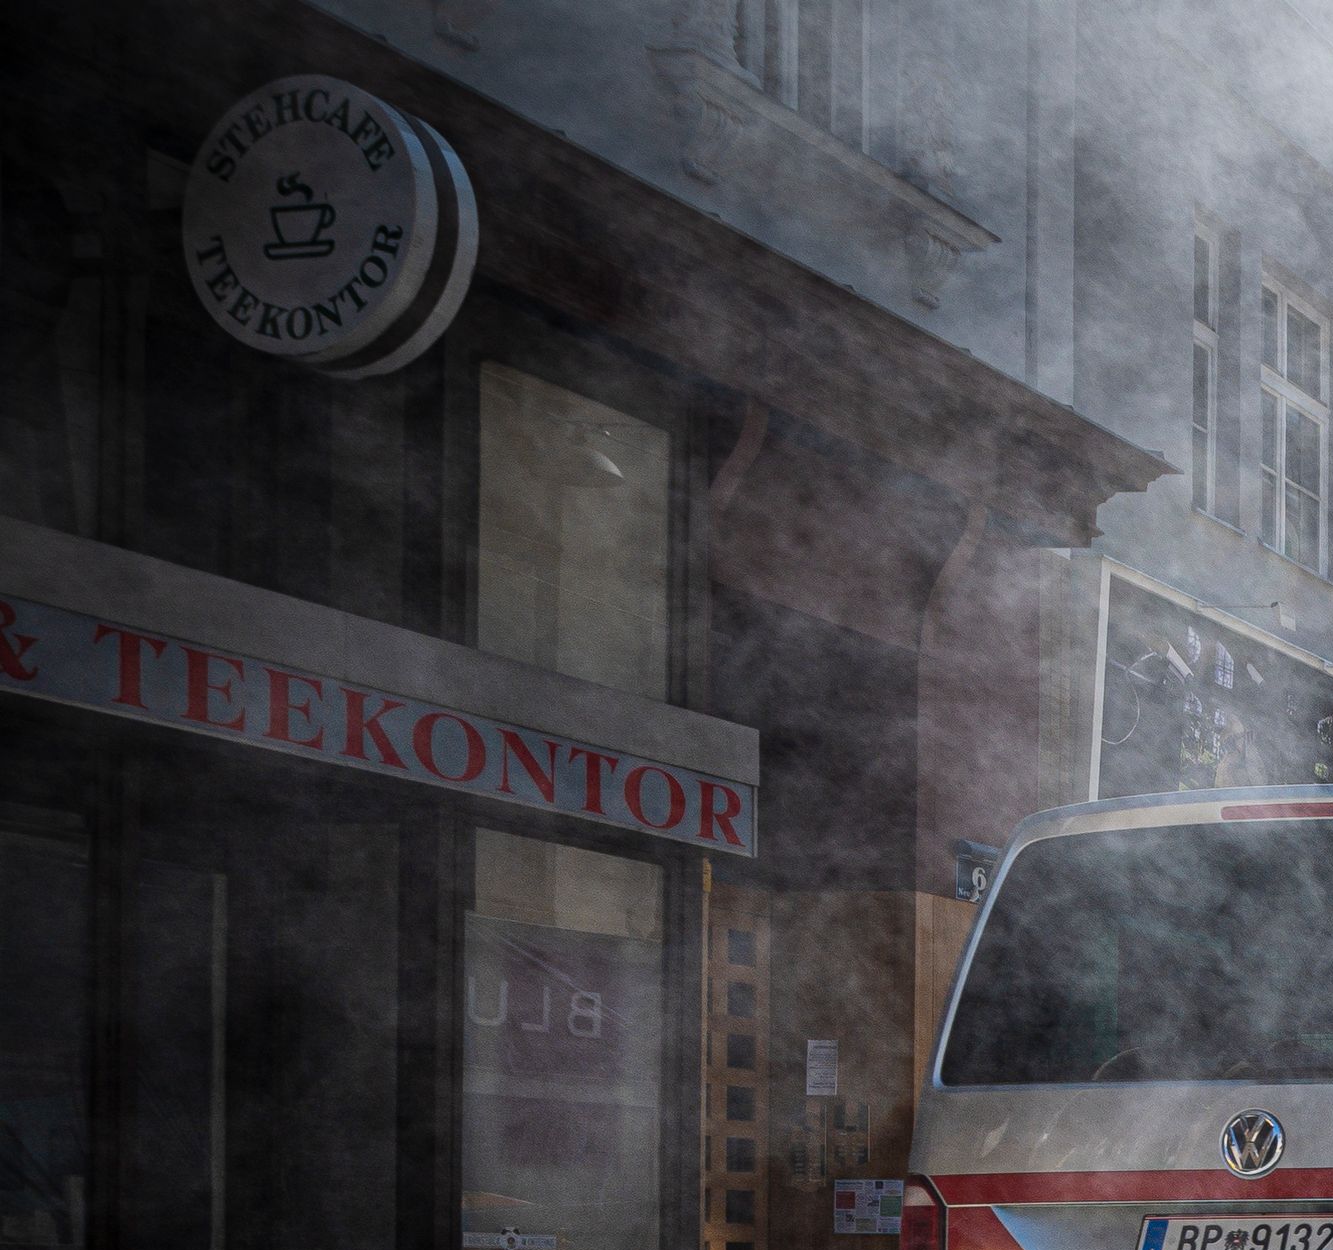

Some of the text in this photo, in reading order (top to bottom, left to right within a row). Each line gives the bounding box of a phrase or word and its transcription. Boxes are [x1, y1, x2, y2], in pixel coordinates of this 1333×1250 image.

[206, 82, 396, 184] STEHCAFE
[194, 220, 404, 342] TEEKONTOR
[93, 623, 747, 849] TEEKONTOR
